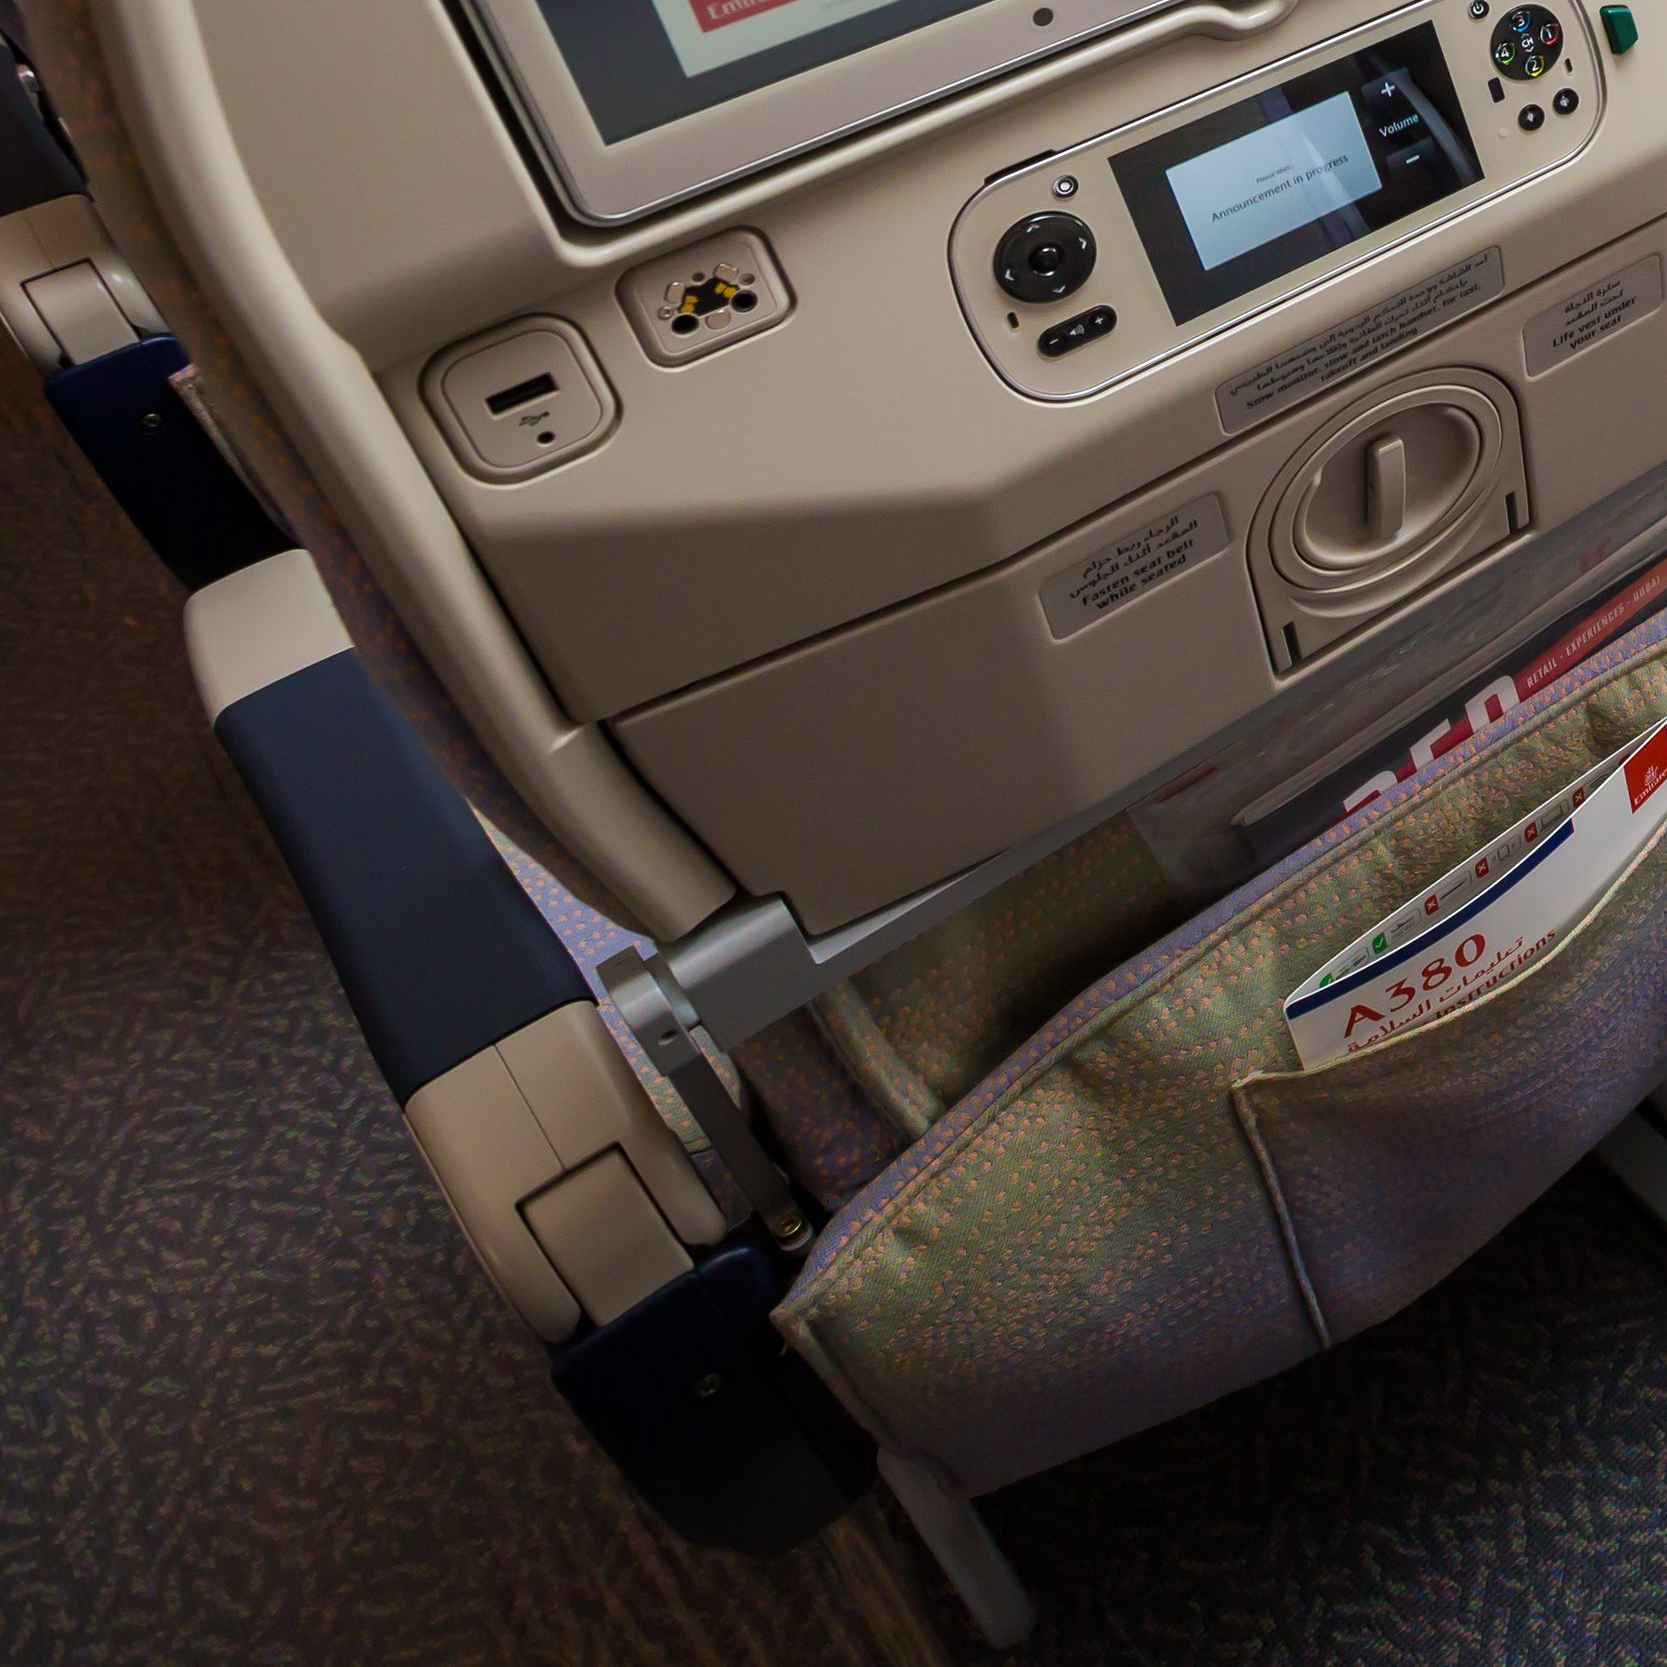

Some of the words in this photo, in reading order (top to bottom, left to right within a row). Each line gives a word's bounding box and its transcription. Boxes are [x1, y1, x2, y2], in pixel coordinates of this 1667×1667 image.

[1516, 14, 1526, 27] 3
[1544, 27, 1552, 39] 1
[1501, 47, 1510, 59] 4
[1521, 36, 1534, 49] CH
[1530, 59, 1540, 72] 2
[1379, 113, 1420, 138] Volume
[1211, 179, 1292, 223] Announcement
[1293, 175, 1304, 186] in
[1305, 153, 1349, 183] progress
[1552, 330, 1575, 348] Life
[1578, 316, 1601, 334] vest
[1604, 296, 1637, 319] under
[1569, 330, 1596, 350] your
[1600, 315, 1621, 332] seat
[1360, 347, 1379, 363] and
[1247, 390, 1274, 410] Stow
[1351, 340, 1370, 356] and
[1081, 575, 1130, 606] Fasten
[1133, 555, 1163, 577] seat
[1166, 539, 1195, 560] belt
[1097, 583, 1138, 610] while
[1141, 554, 1187, 587] seated
[1526, 656, 1558, 688] RETAIL
[1565, 603, 1626, 657] EXPERIENCES
[1632, 574, 1662, 604] DUBAI
[1344, 933, 1487, 1039] A380
